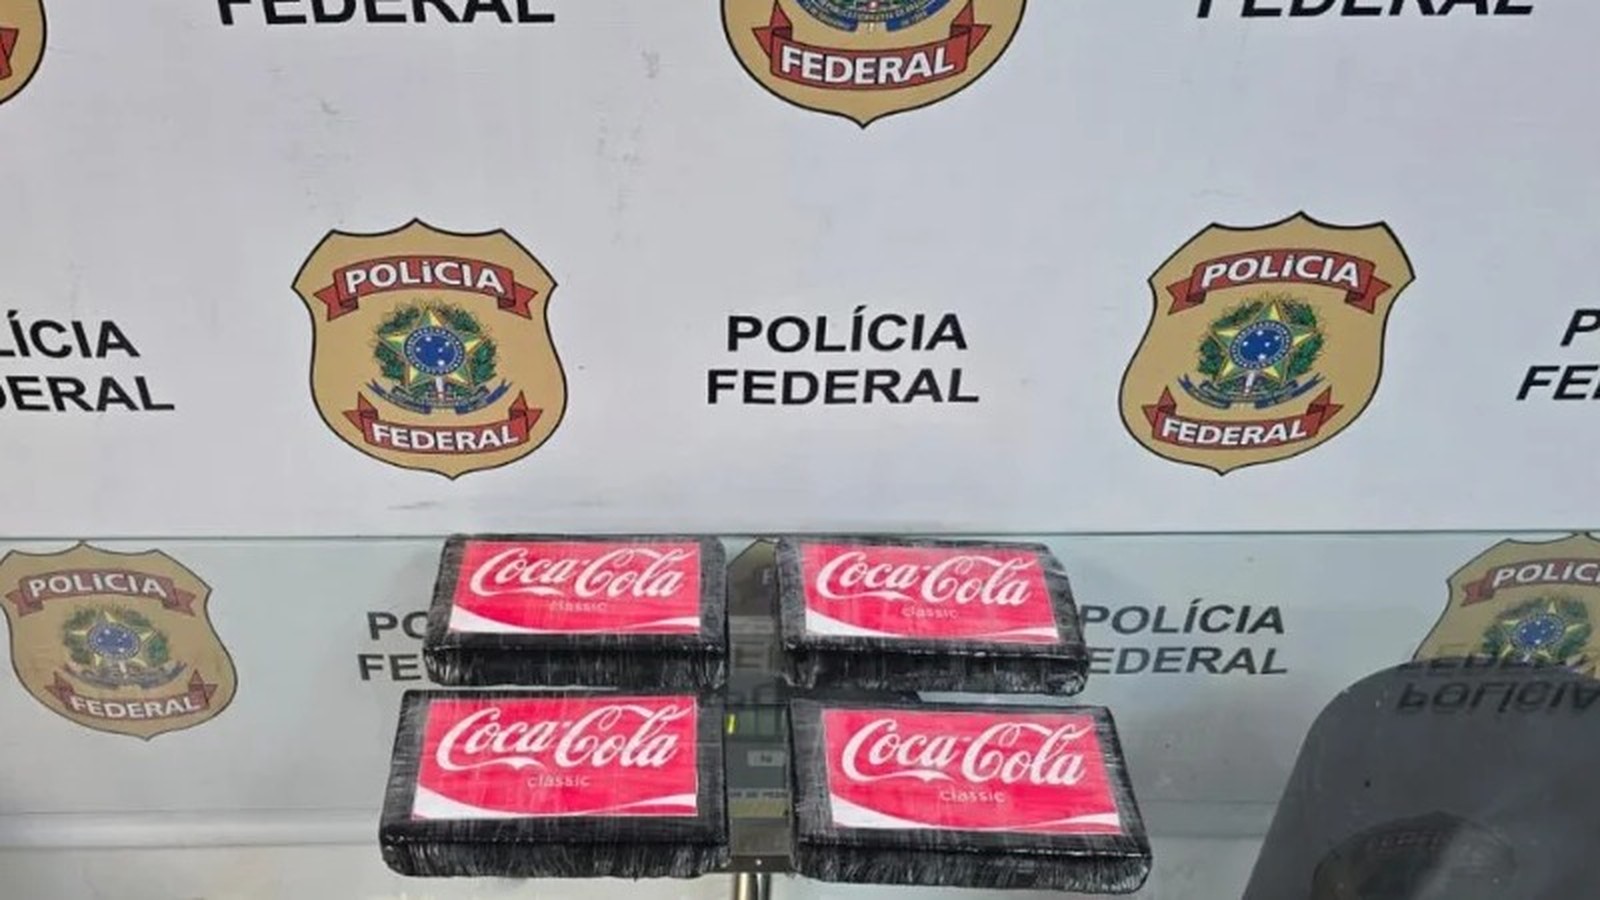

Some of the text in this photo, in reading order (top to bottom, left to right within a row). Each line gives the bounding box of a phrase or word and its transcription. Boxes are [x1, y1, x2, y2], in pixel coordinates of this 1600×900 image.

[782, 45, 955, 85] FEDERAL
[727, 305, 968, 352] POLÍCIA
[706, 368, 980, 405] FEDERAL
[371, 422, 520, 451] FEDERAL
[1161, 418, 1307, 447] FEDERAL
[902, 605, 960, 620] classic
[1081, 598, 1284, 634] POLÍCIA
[1088, 646, 1288, 675] EDERAL
[70, 696, 201, 719] FEDERAL
[527, 773, 591, 788] classic
[939, 787, 1006, 803] classic
